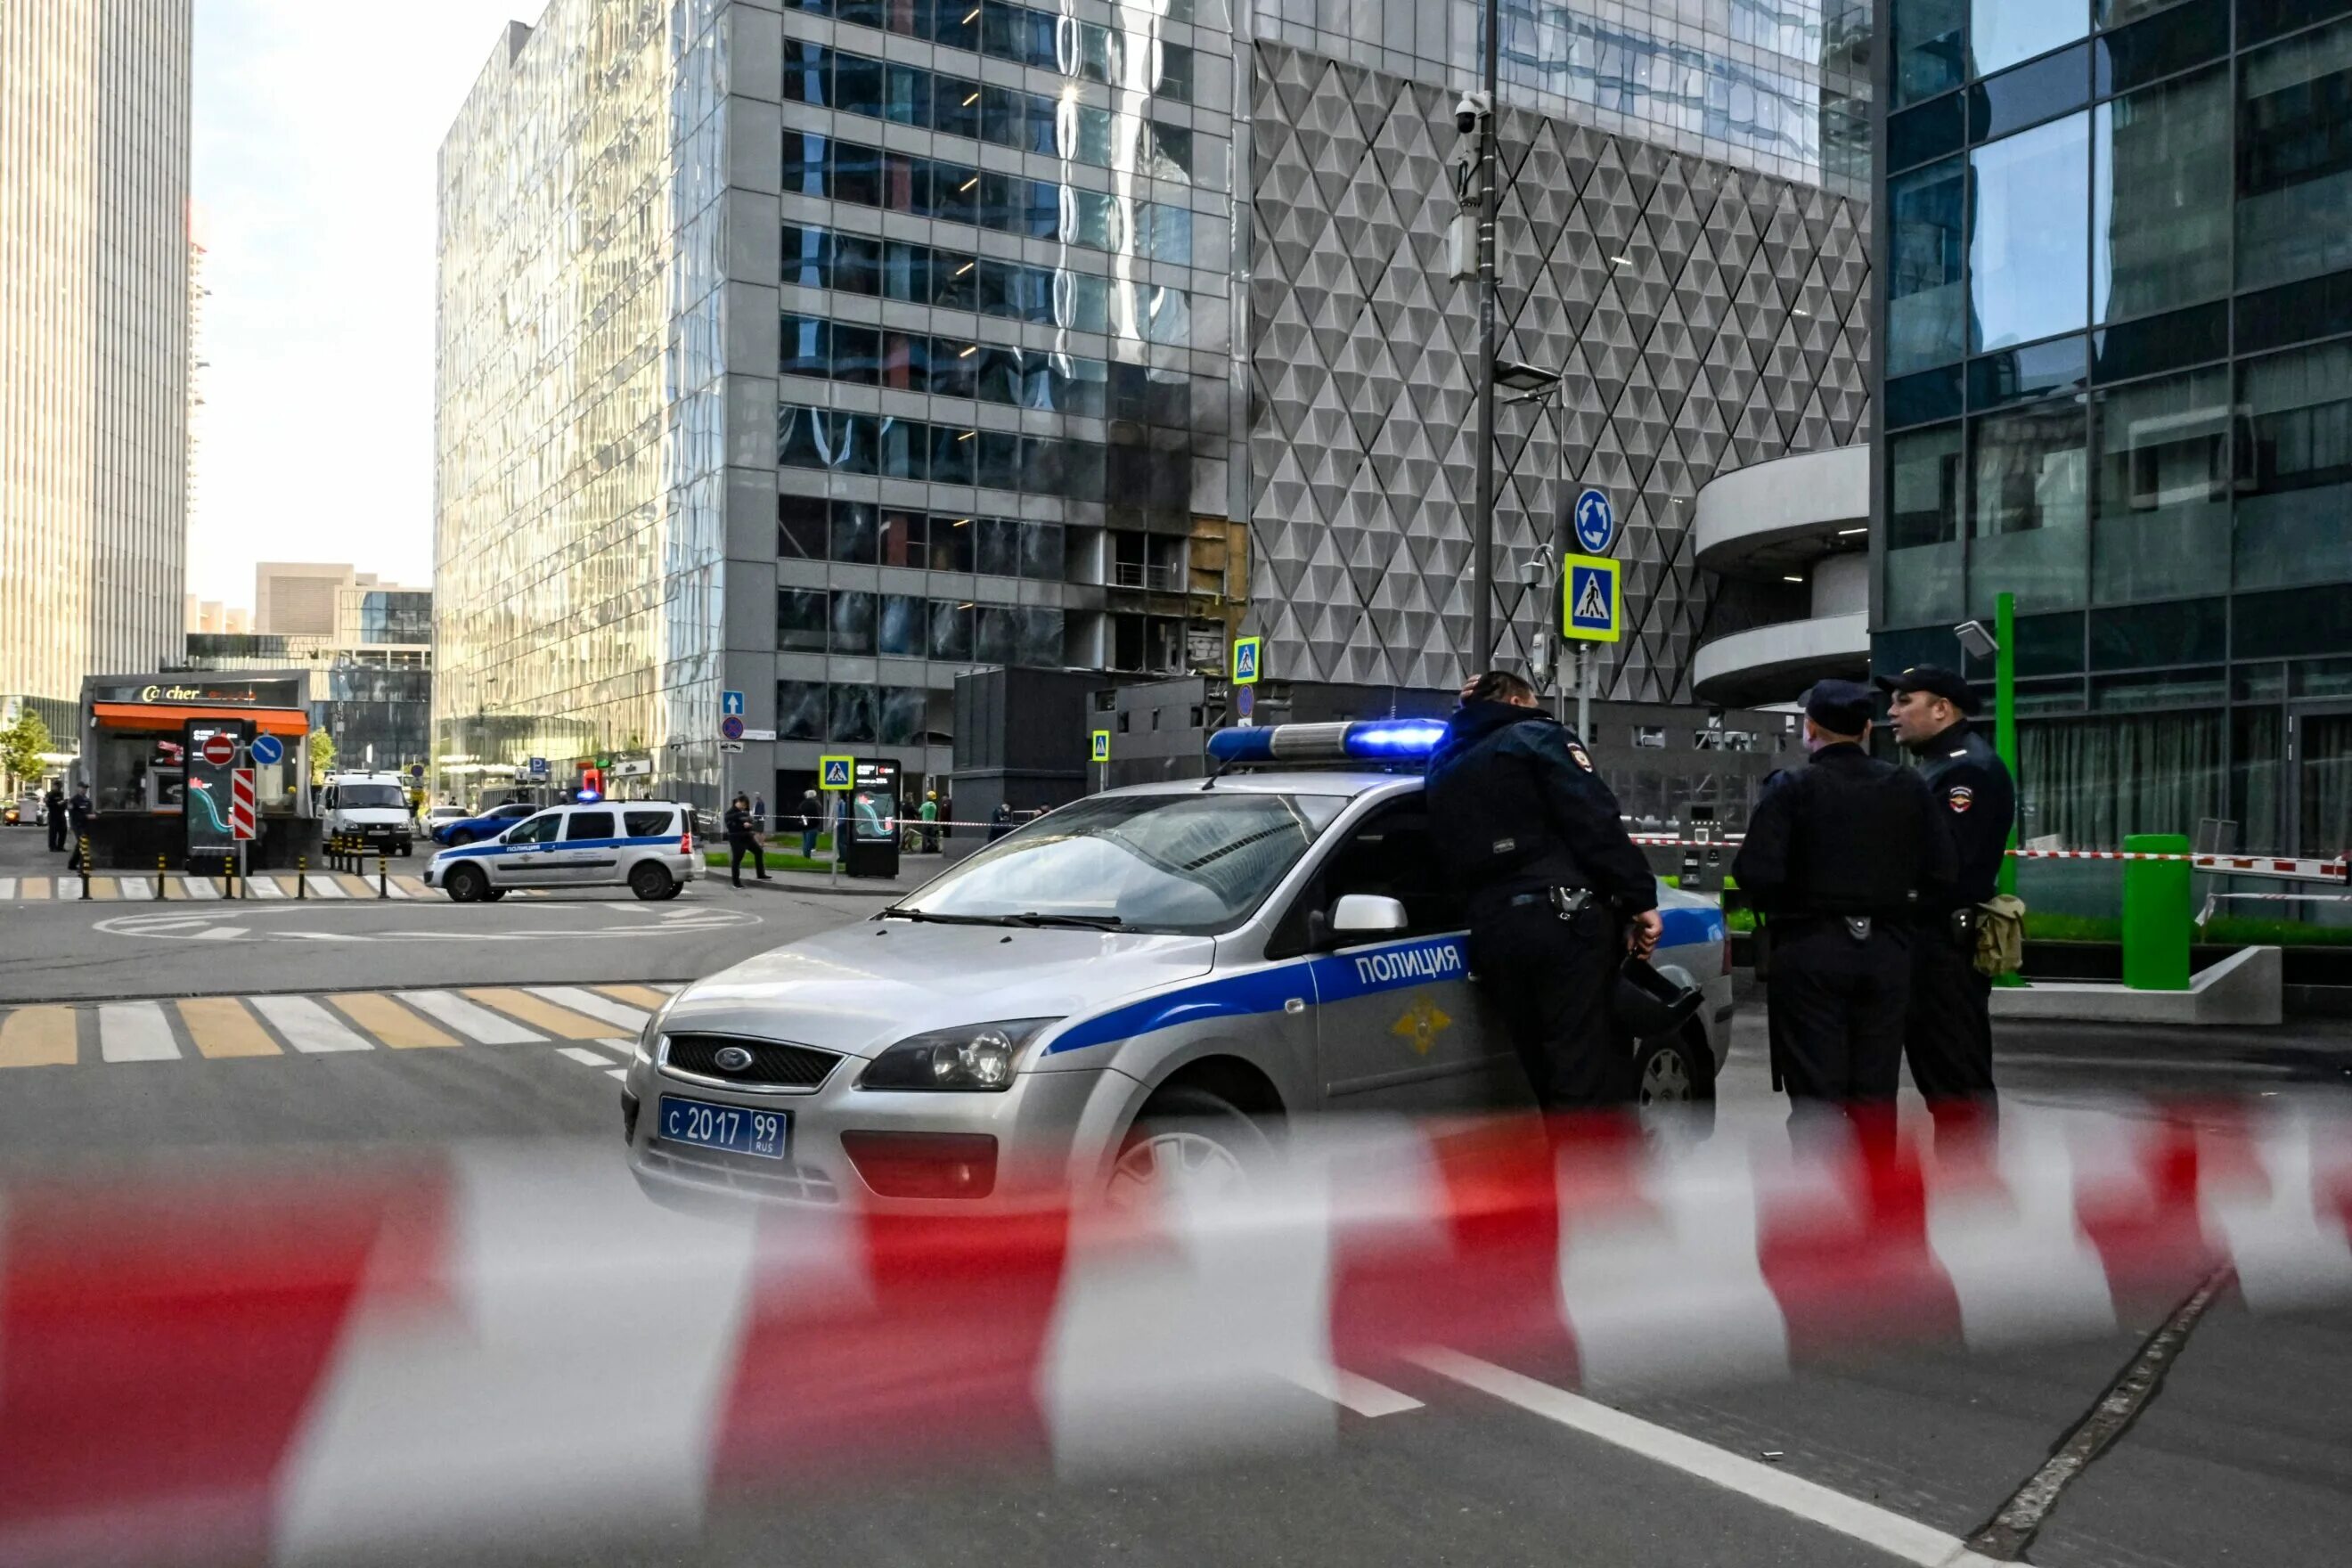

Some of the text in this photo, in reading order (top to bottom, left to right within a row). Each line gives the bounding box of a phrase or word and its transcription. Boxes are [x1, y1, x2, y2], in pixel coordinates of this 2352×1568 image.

[506, 845, 541, 853] ПОЛИЦИЯ
[1355, 945, 1461, 984] ПОЛИЦИЯ
[687, 1107, 739, 1145] 2017
[755, 1115, 777, 1141] 99
[755, 1142, 773, 1153] RUS
